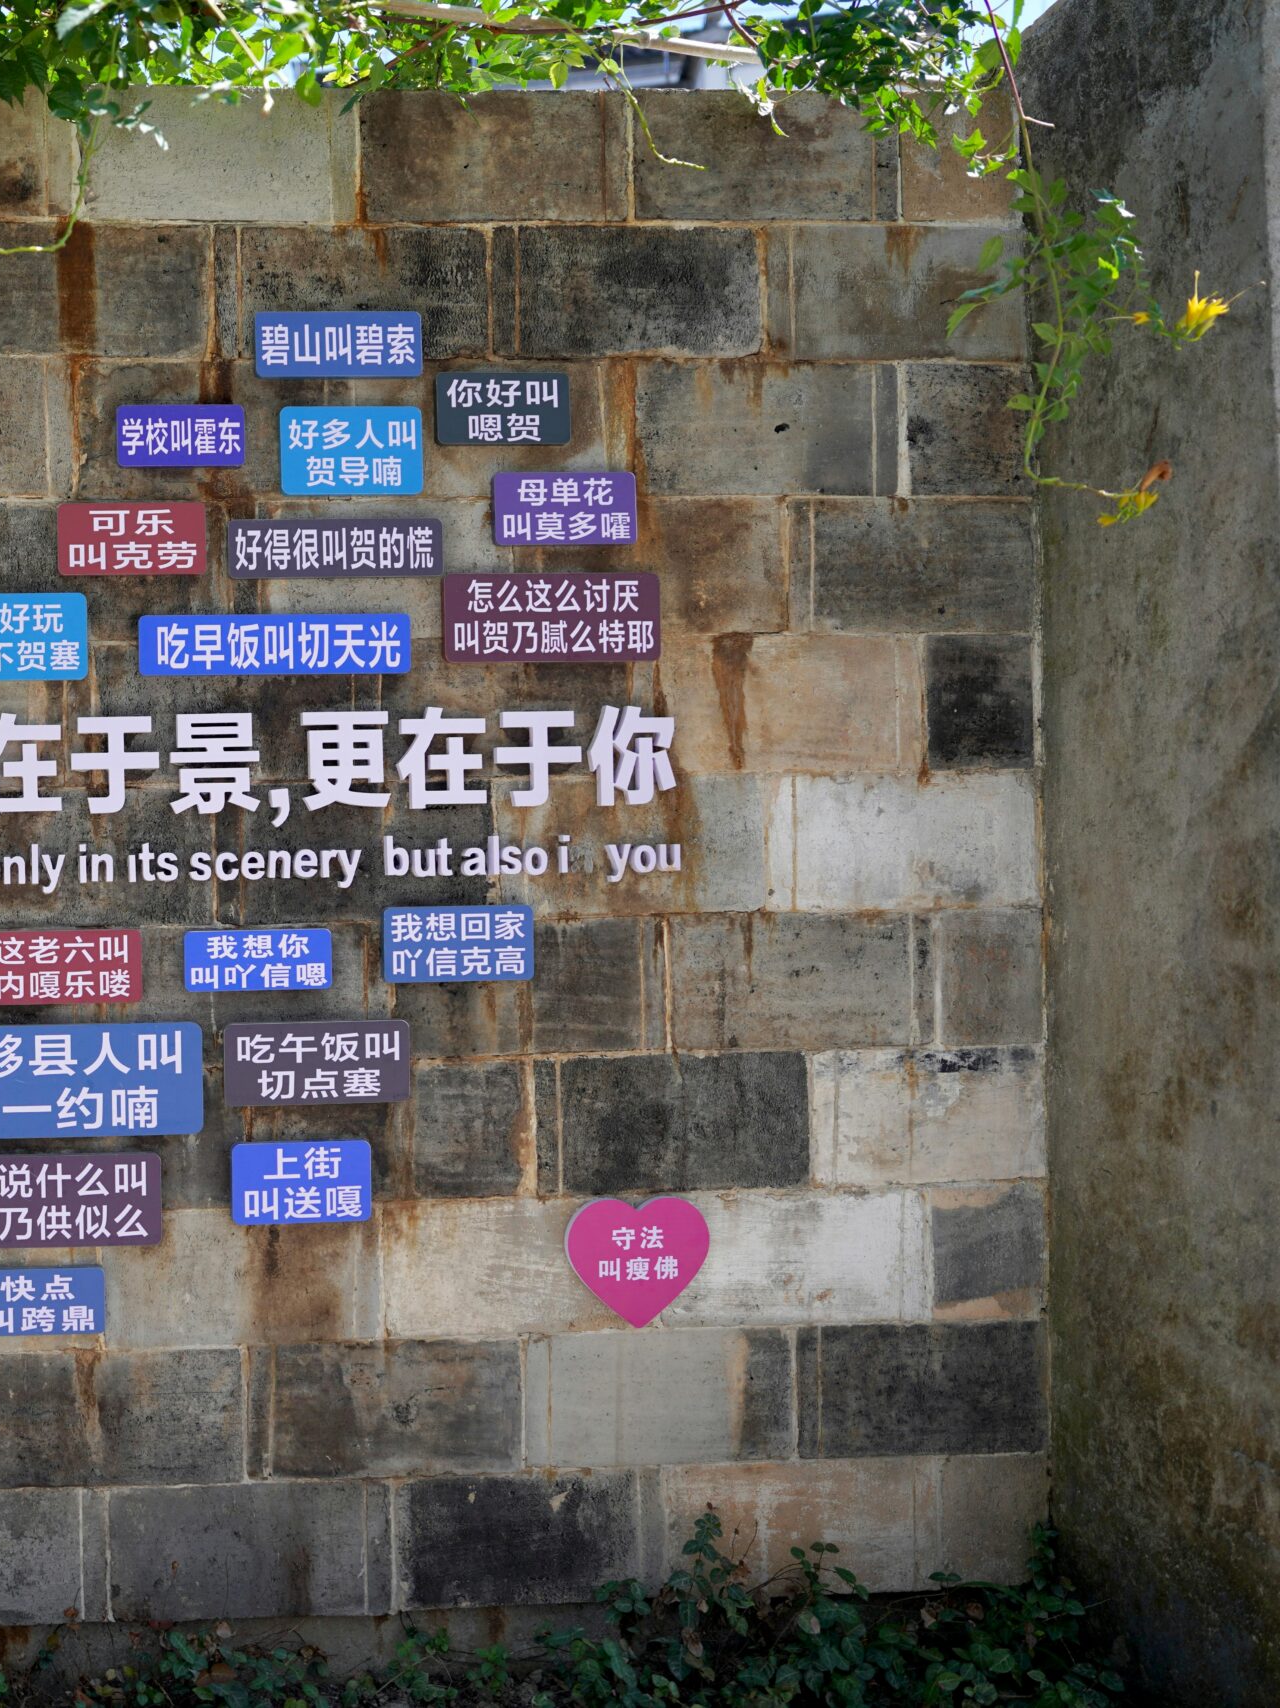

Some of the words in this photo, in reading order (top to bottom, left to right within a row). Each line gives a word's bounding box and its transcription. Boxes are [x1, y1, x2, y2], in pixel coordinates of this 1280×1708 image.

[262, 324, 415, 365] 碧山叫碧索
[447, 379, 558, 407] 你好叫
[122, 418, 240, 455] 学校叫霍东
[289, 419, 415, 449] 好多人叫
[469, 413, 541, 441] 嗯贺
[307, 456, 401, 486] 贺导喃
[518, 478, 613, 506] 母单花
[89, 509, 174, 536] 可乐
[504, 512, 630, 540] 叫莫多嚯
[70, 541, 196, 569] 叫克劳
[236, 527, 433, 570] 好得很叫贺的慌
[468, 579, 638, 612] 怎么这么讨厌
[157, 622, 400, 669] 吃早饭叫切天光
[455, 620, 653, 654] 叫贺乃腻么特耶
[78, 843, 114, 885] in
[127, 842, 178, 884] its
[188, 845, 362, 889] scenery
[384, 834, 453, 877] but
[461, 834, 545, 877] also
[605, 841, 682, 885] you
[391, 911, 524, 942] 我想回家
[207, 934, 309, 959] 我想你
[393, 946, 525, 976] 吖信克高
[191, 963, 327, 989] 叫吖信嗯
[237, 1031, 399, 1063] 吃午饭叫
[258, 1068, 380, 1099] 切点塞
[264, 1147, 341, 1179] 上街
[245, 1186, 362, 1220] 叫送嘎
[612, 1226, 663, 1250] 守法
[599, 1256, 678, 1281] 叫瘦佛
[0, 1275, 74, 1301] 快点
